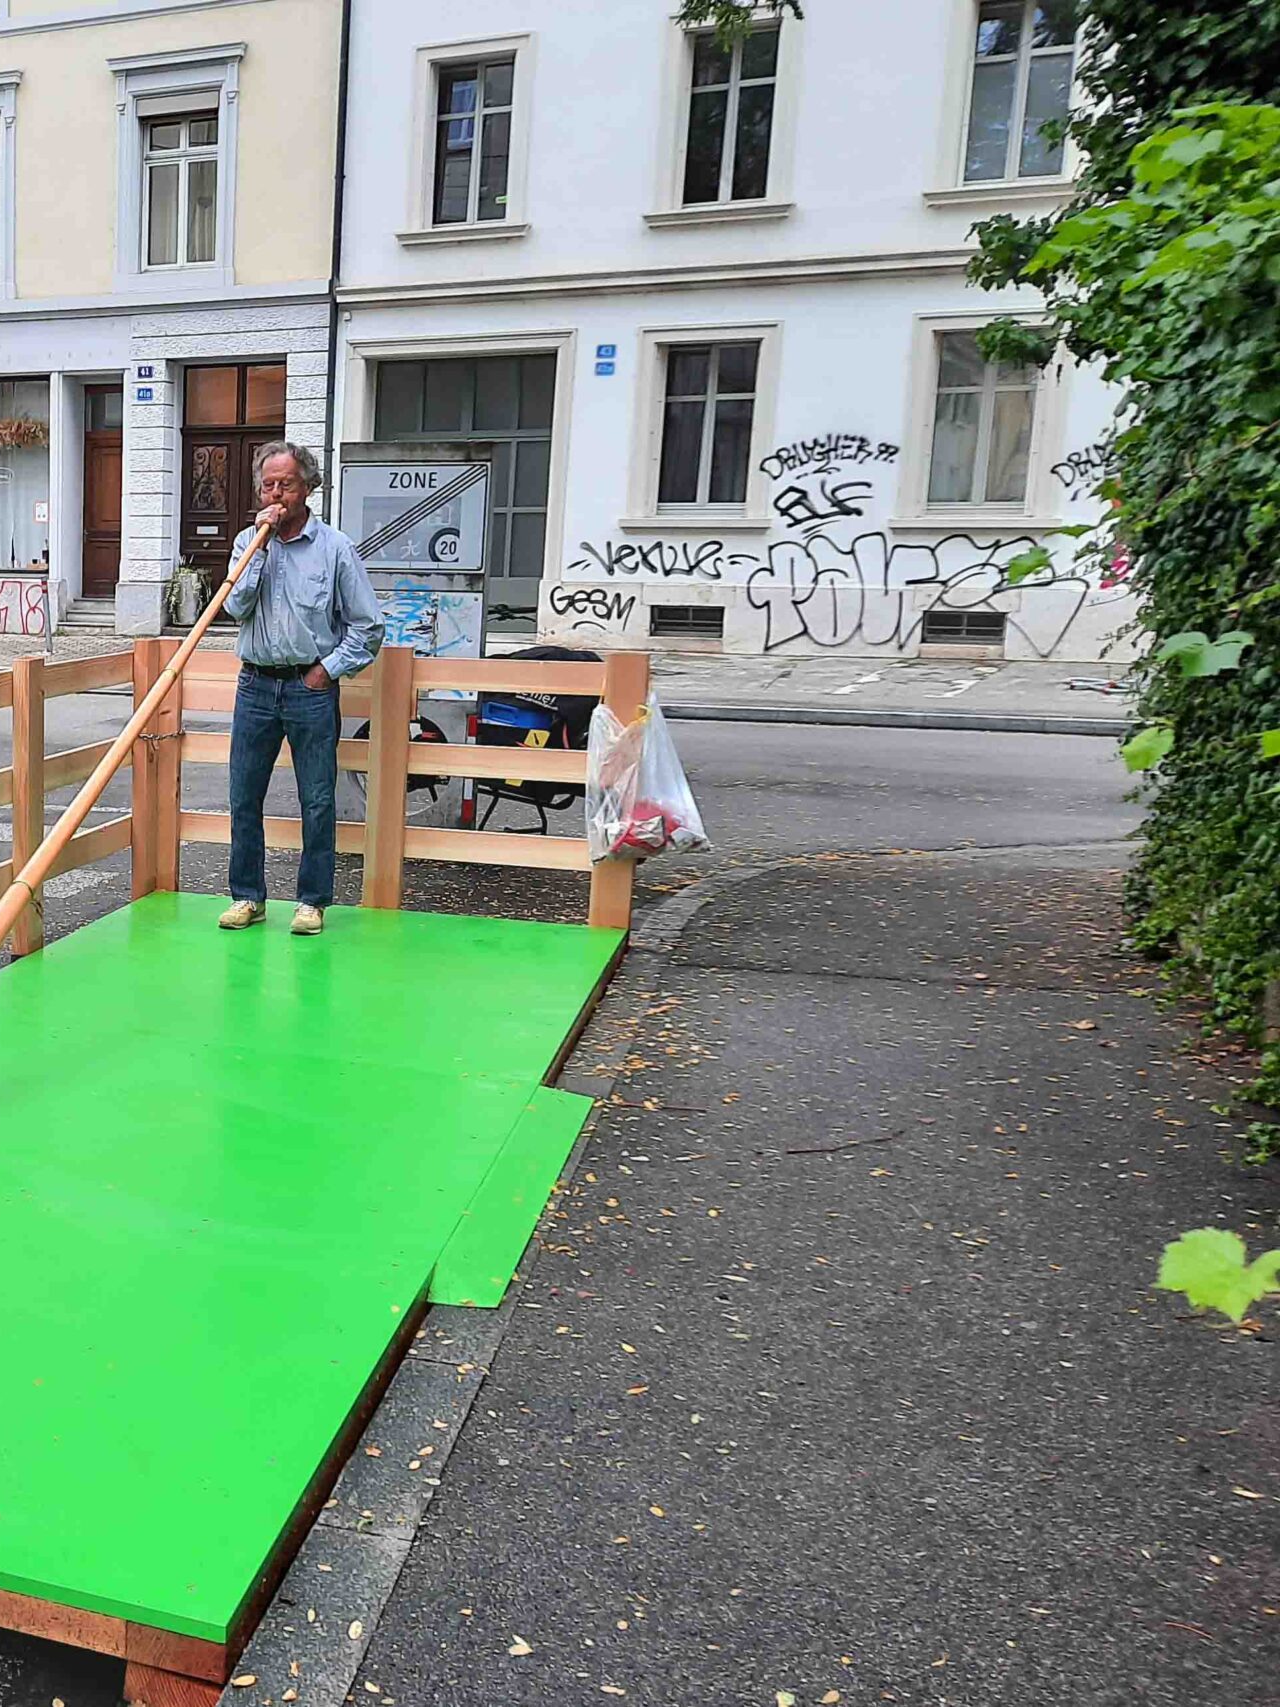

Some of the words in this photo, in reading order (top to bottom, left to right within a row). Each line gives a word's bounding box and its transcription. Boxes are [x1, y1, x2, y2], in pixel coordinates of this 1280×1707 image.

[140, 367, 150, 376] 41
[389, 472, 438, 488] ZONE
[440, 541, 457, 555] 20
